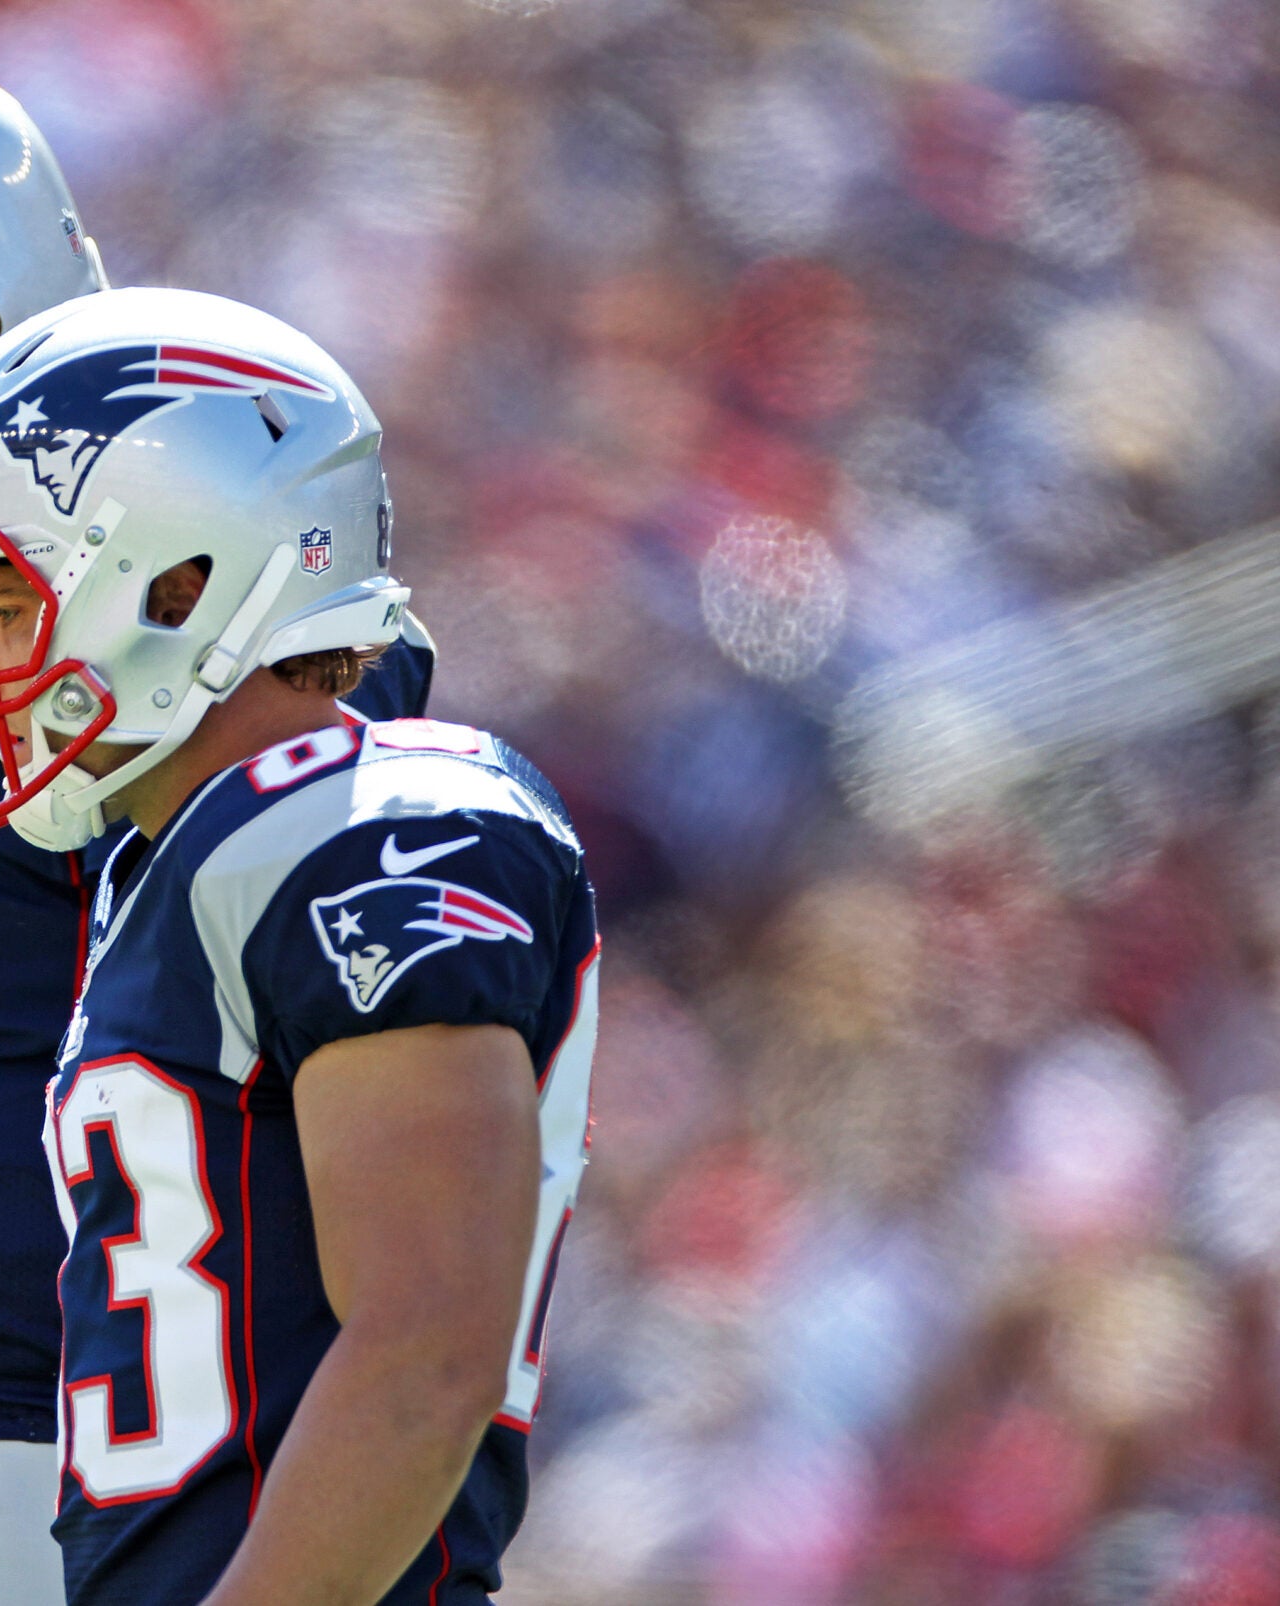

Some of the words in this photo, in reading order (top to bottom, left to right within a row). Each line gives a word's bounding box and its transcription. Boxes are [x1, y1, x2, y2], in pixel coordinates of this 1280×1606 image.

[24, 544, 54, 556] PEED
[303, 546, 330, 570] NFL
[42, 1052, 239, 1513] 3
